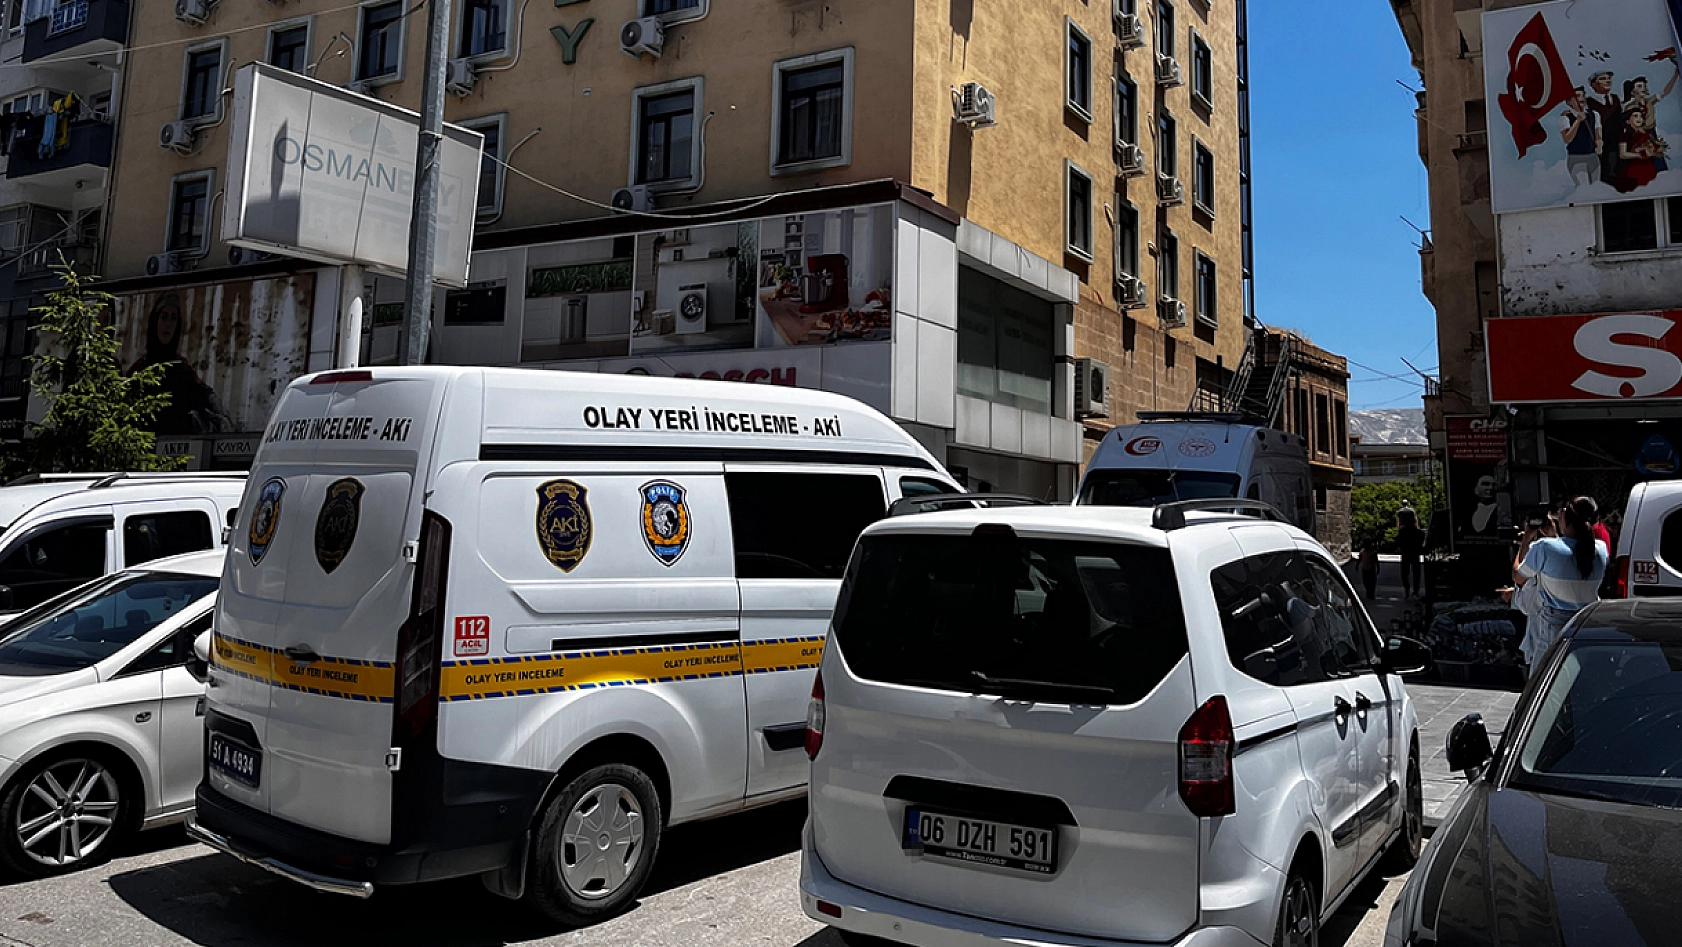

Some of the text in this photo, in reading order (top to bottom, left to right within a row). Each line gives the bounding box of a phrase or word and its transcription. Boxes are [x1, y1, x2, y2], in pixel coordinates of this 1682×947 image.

[549, 0, 595, 65] Y
[275, 136, 456, 207] OSMANBY
[308, 417, 373, 440] İNCELEME
[379, 417, 412, 442] AKİ
[582, 405, 643, 429] OLAY
[648, 405, 700, 431] YERİ
[704, 406, 799, 435] İNCELEME
[813, 415, 842, 437] AKİ
[1635, 562, 1656, 573] 112
[459, 619, 486, 636] 112
[664, 659, 683, 669] OLAY
[465, 673, 491, 685] OLAY
[223, 746, 230, 766] A
[231, 750, 254, 776] 4934
[920, 815, 1048, 861] 06 DZH 591
